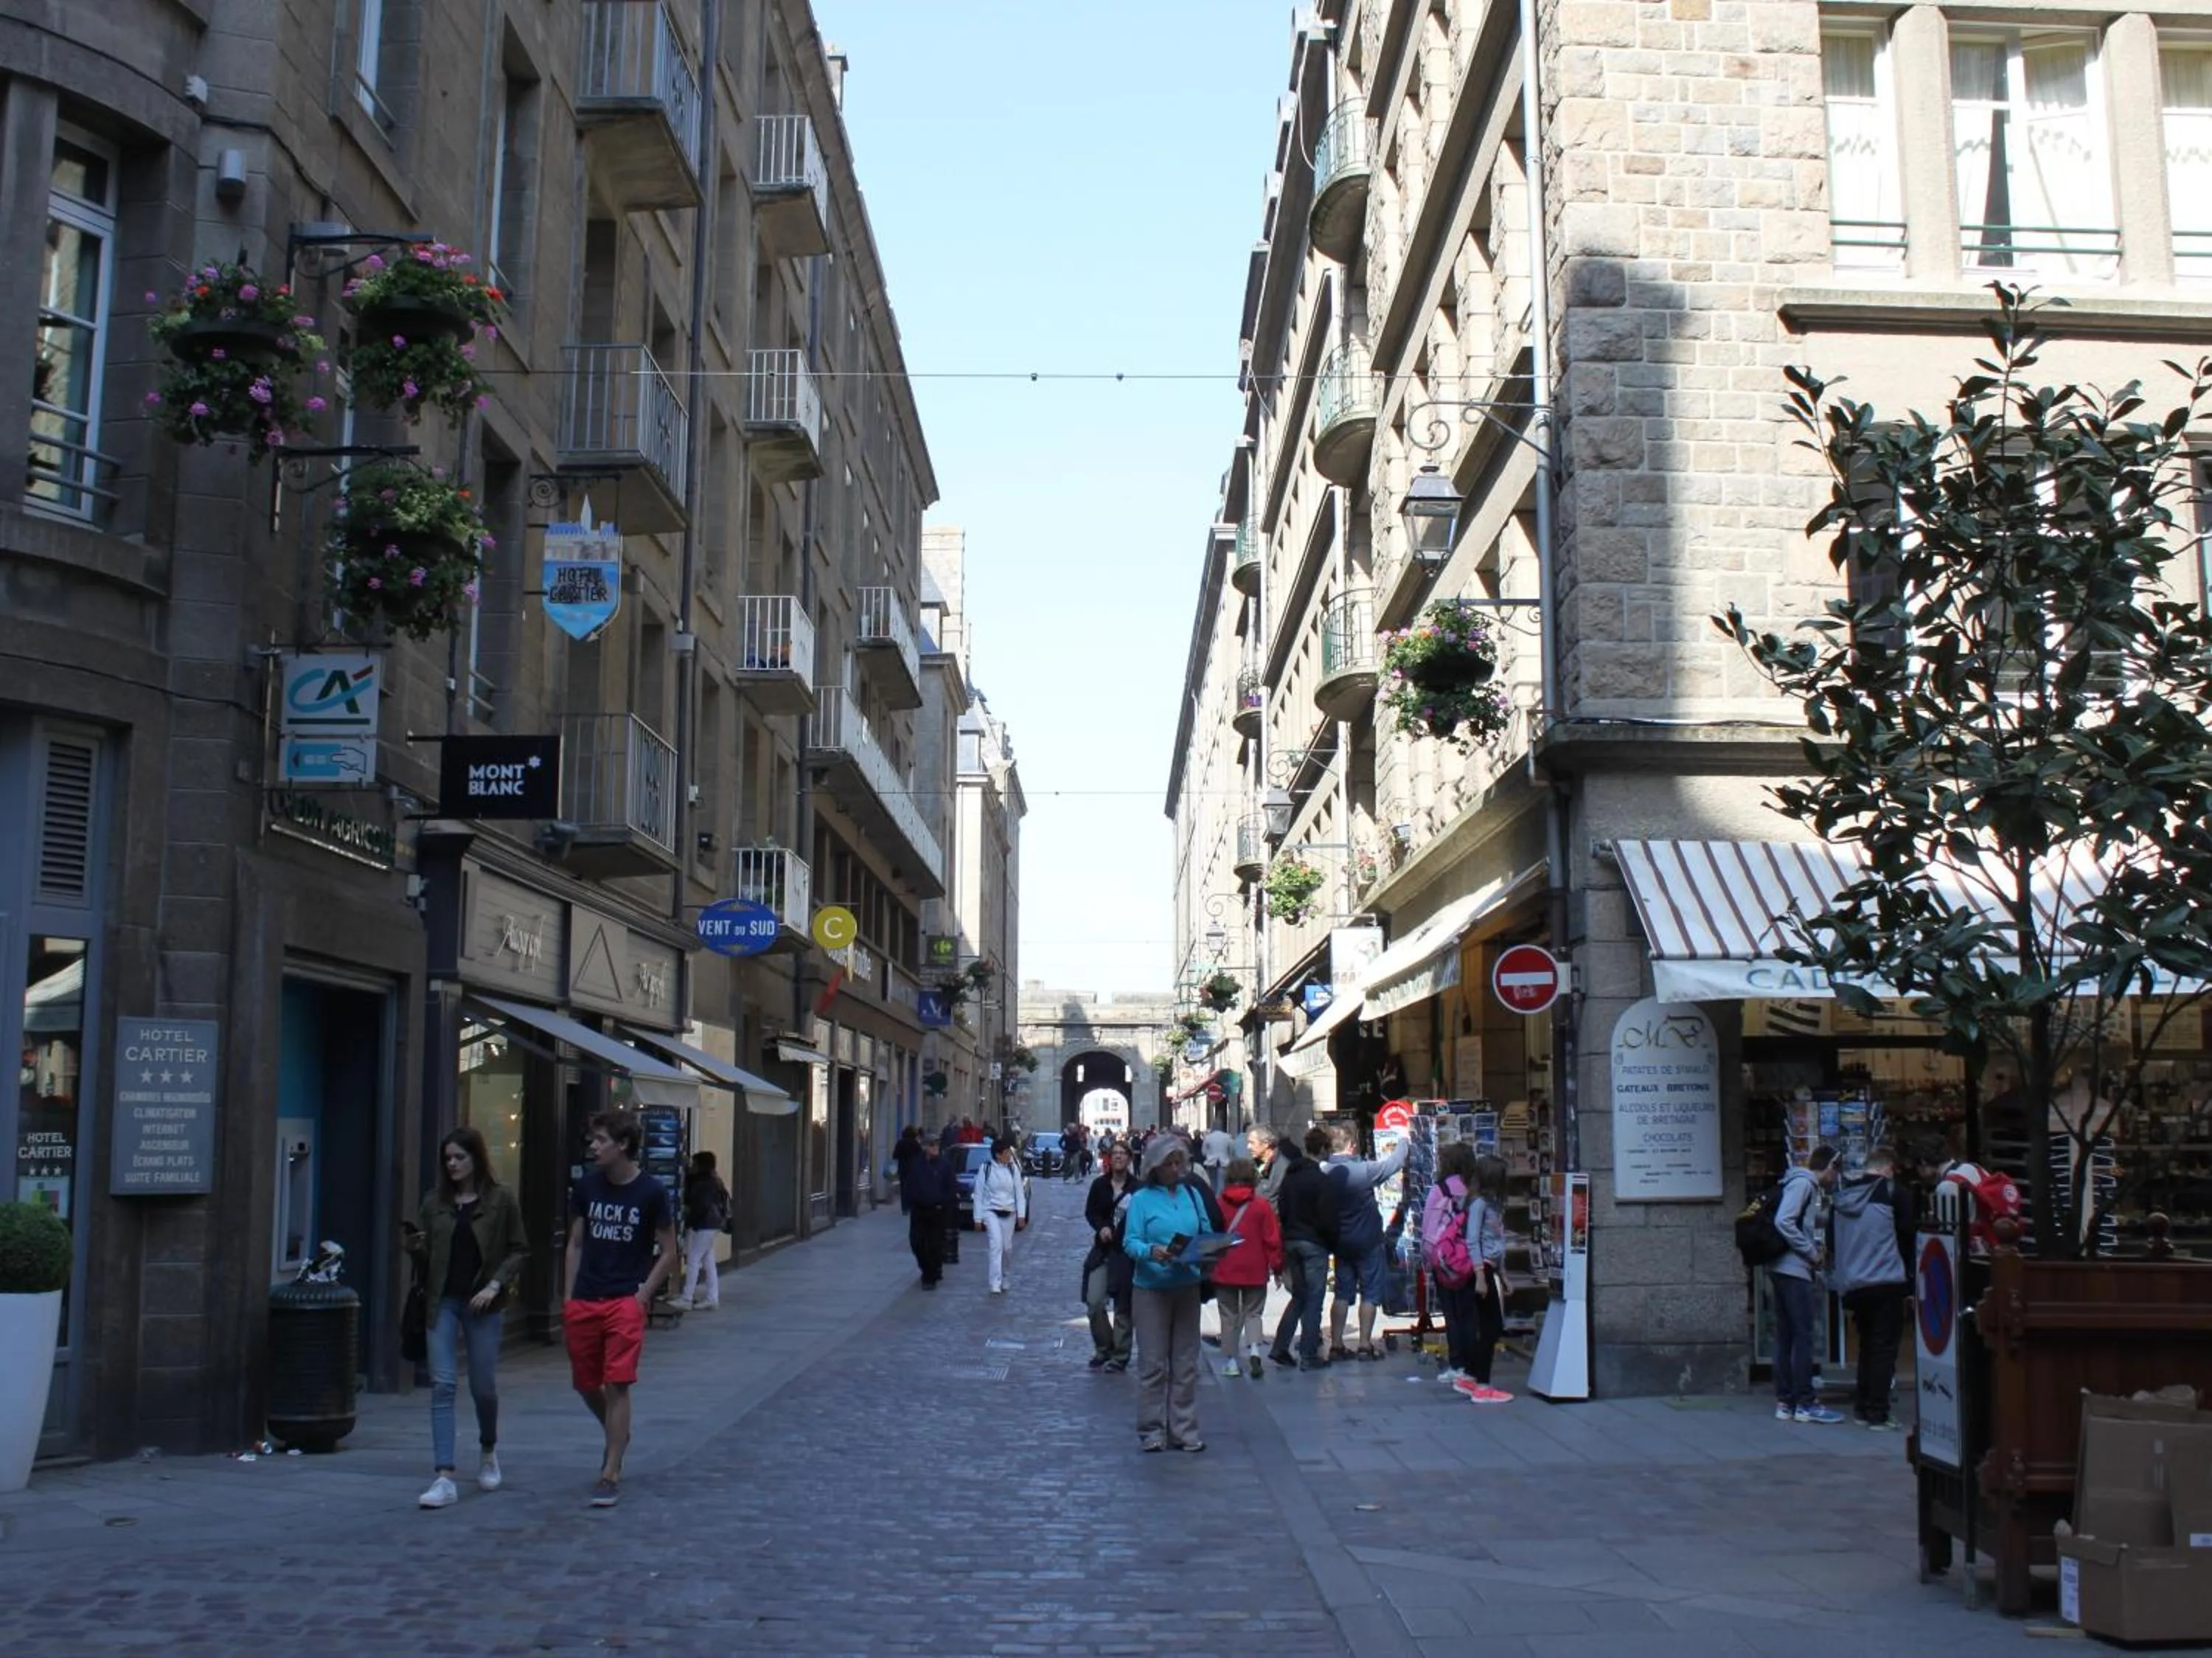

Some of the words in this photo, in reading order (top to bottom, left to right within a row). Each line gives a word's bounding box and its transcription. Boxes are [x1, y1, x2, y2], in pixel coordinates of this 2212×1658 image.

[468, 764, 525, 779] MONT
[468, 780, 524, 795] BLANC
[698, 920, 731, 935] VENT
[750, 920, 774, 935] SUD
[824, 917, 843, 939] C
[139, 1029, 194, 1042] HOTEL
[125, 1047, 208, 1063] CARTIER
[1666, 1083, 1709, 1092] BRETONS
[27, 1132, 66, 1142] HOTEL
[18, 1145, 72, 1159] CARTIER
[628, 1207, 640, 1225] &
